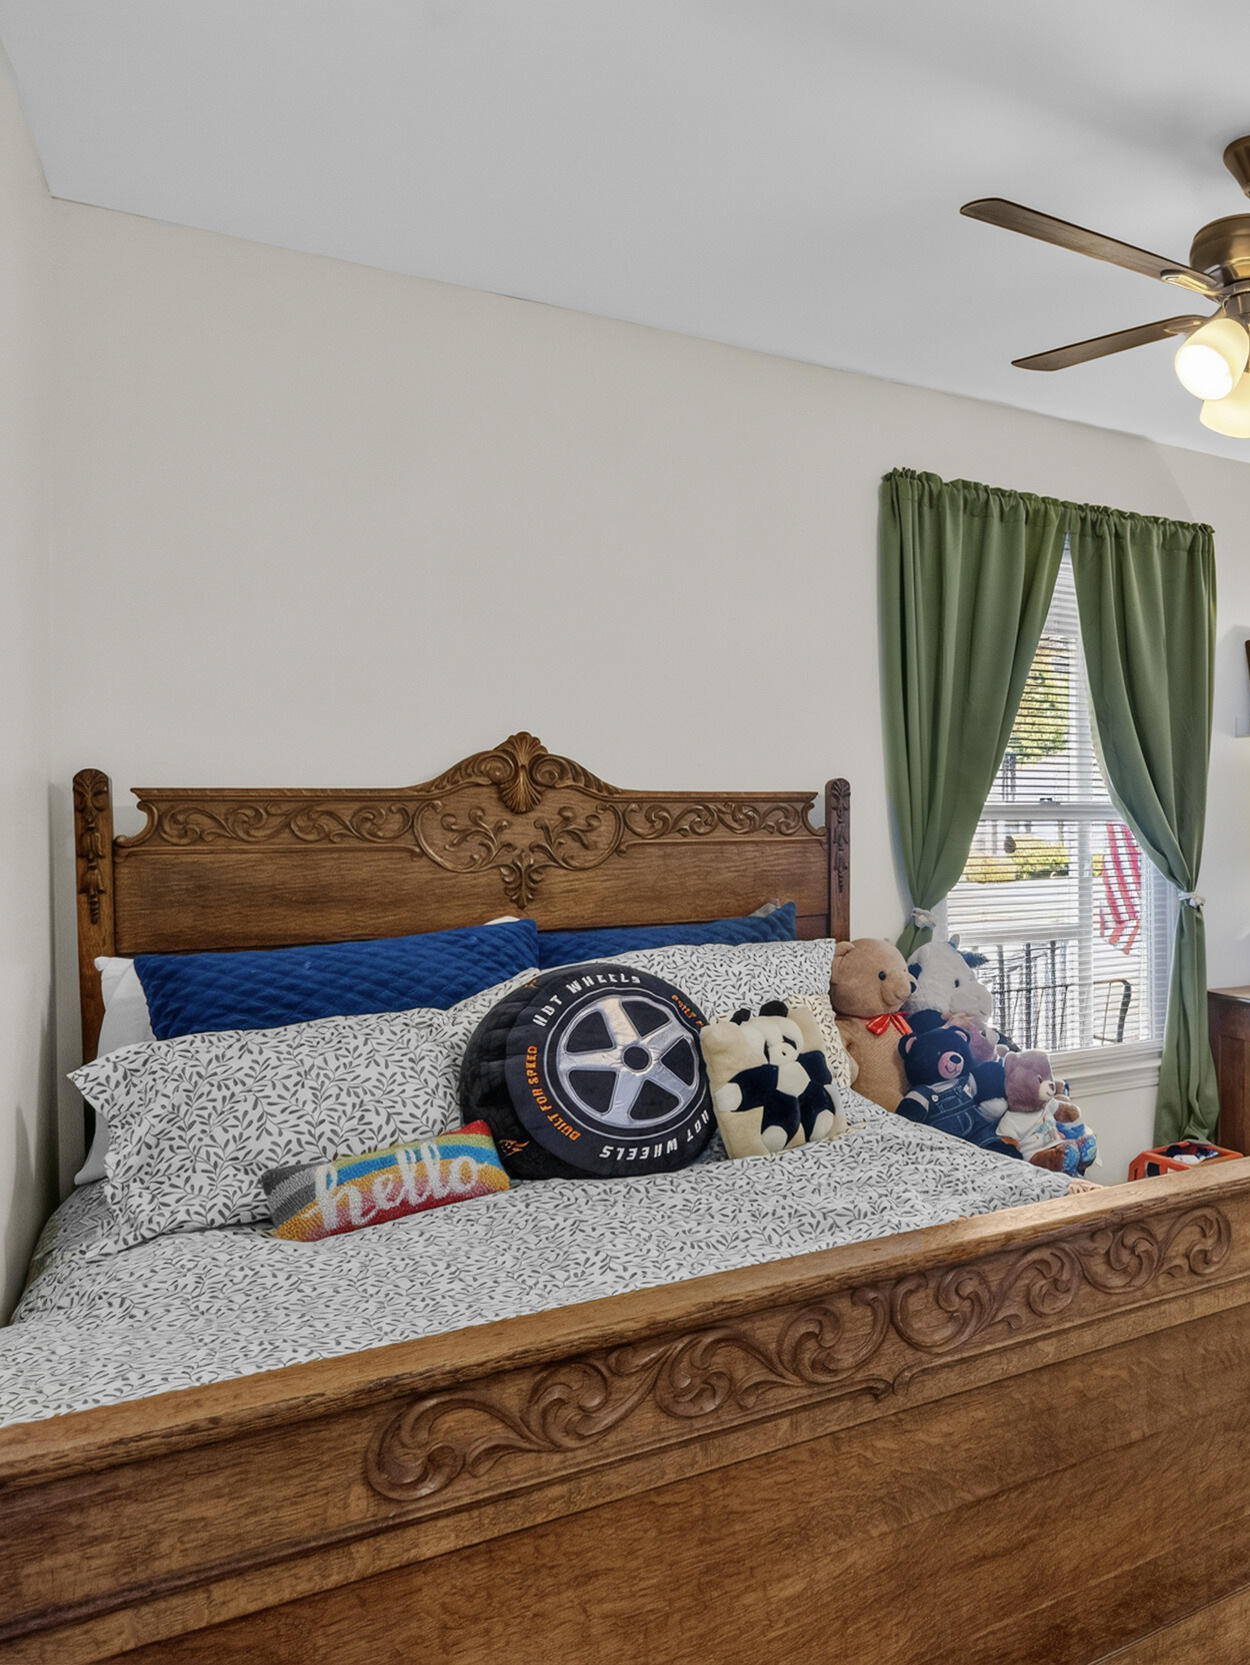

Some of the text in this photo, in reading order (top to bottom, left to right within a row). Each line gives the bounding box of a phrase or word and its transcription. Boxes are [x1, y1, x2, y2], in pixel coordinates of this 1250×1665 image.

[532, 973, 641, 1027] HOT WHEELS
[525, 1045, 581, 1141] BUILT FOR SPEED
[599, 1109, 709, 1160] HOT WHEELS
[303, 1142, 484, 1232] hello
